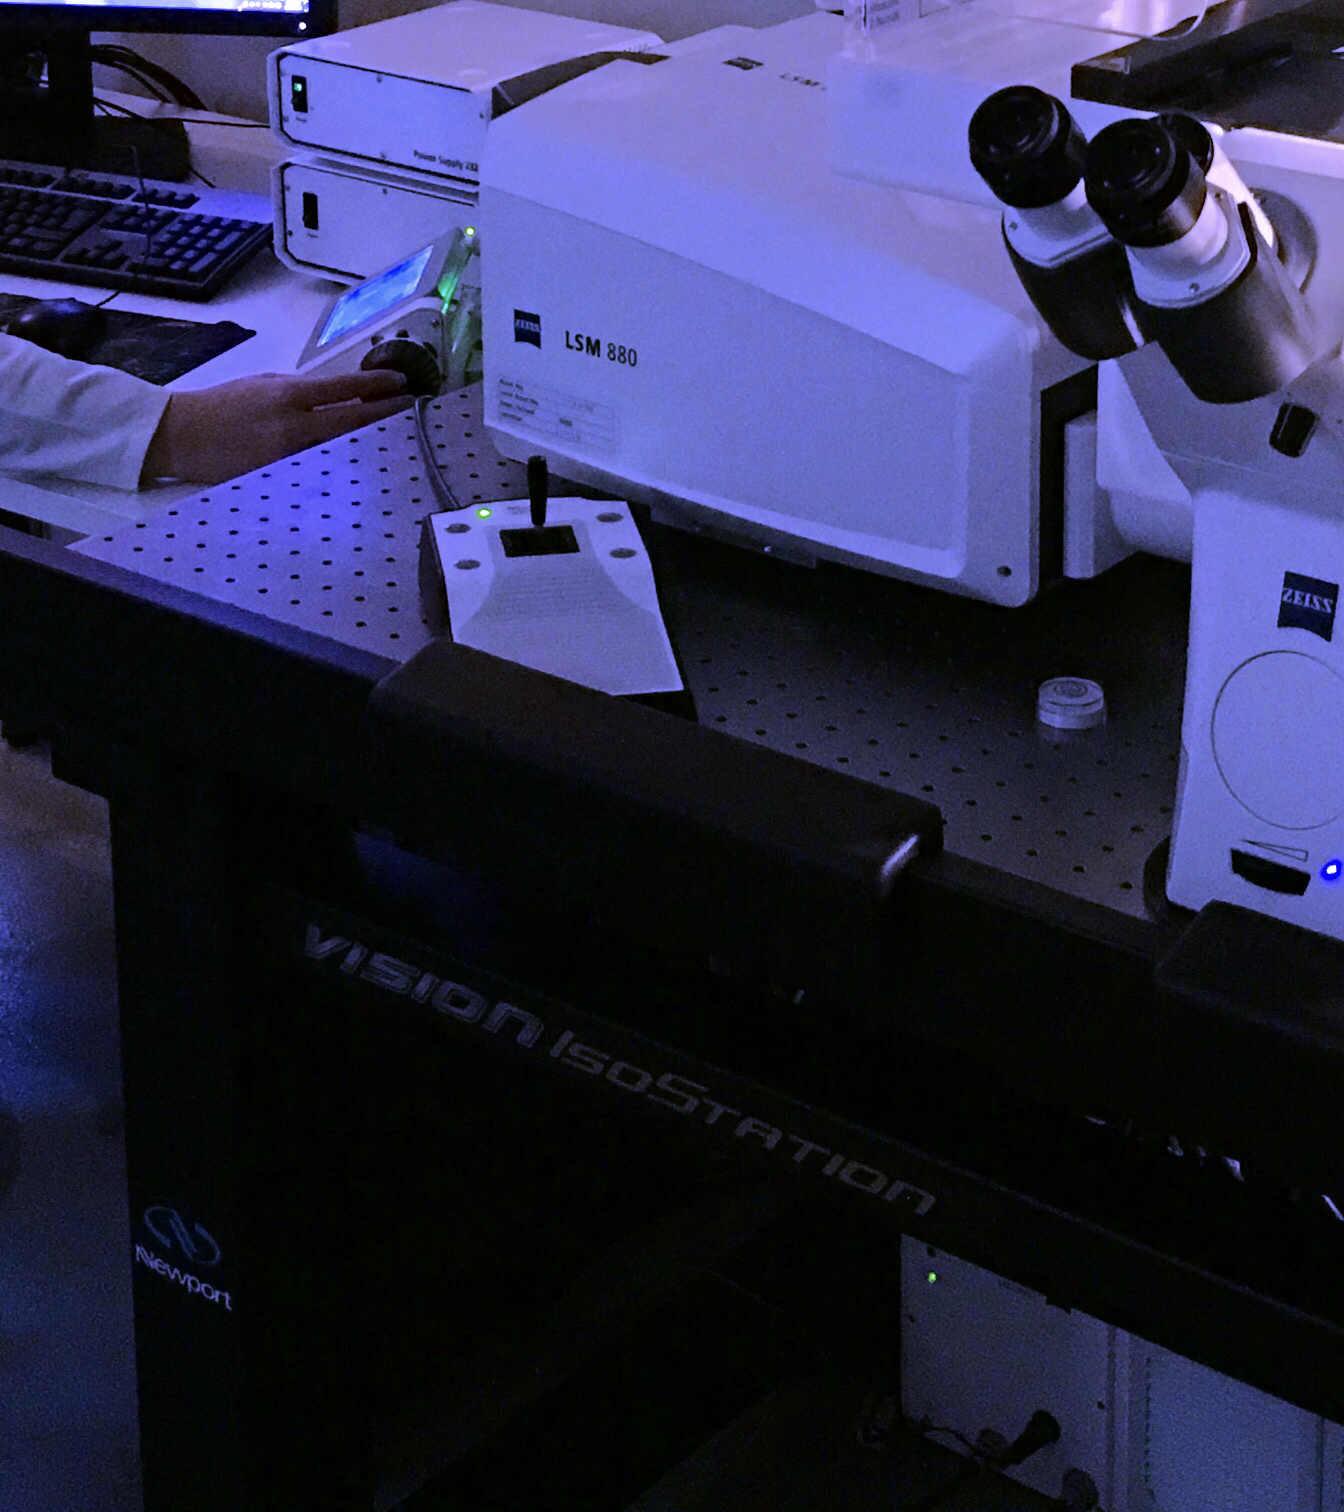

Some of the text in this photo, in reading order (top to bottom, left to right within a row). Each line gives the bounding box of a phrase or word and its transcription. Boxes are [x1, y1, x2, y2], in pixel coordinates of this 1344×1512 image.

[565, 330, 637, 367] LSM 880
[1282, 588, 1334, 614] ZEISS
[135, 1242, 232, 1311] Newport
